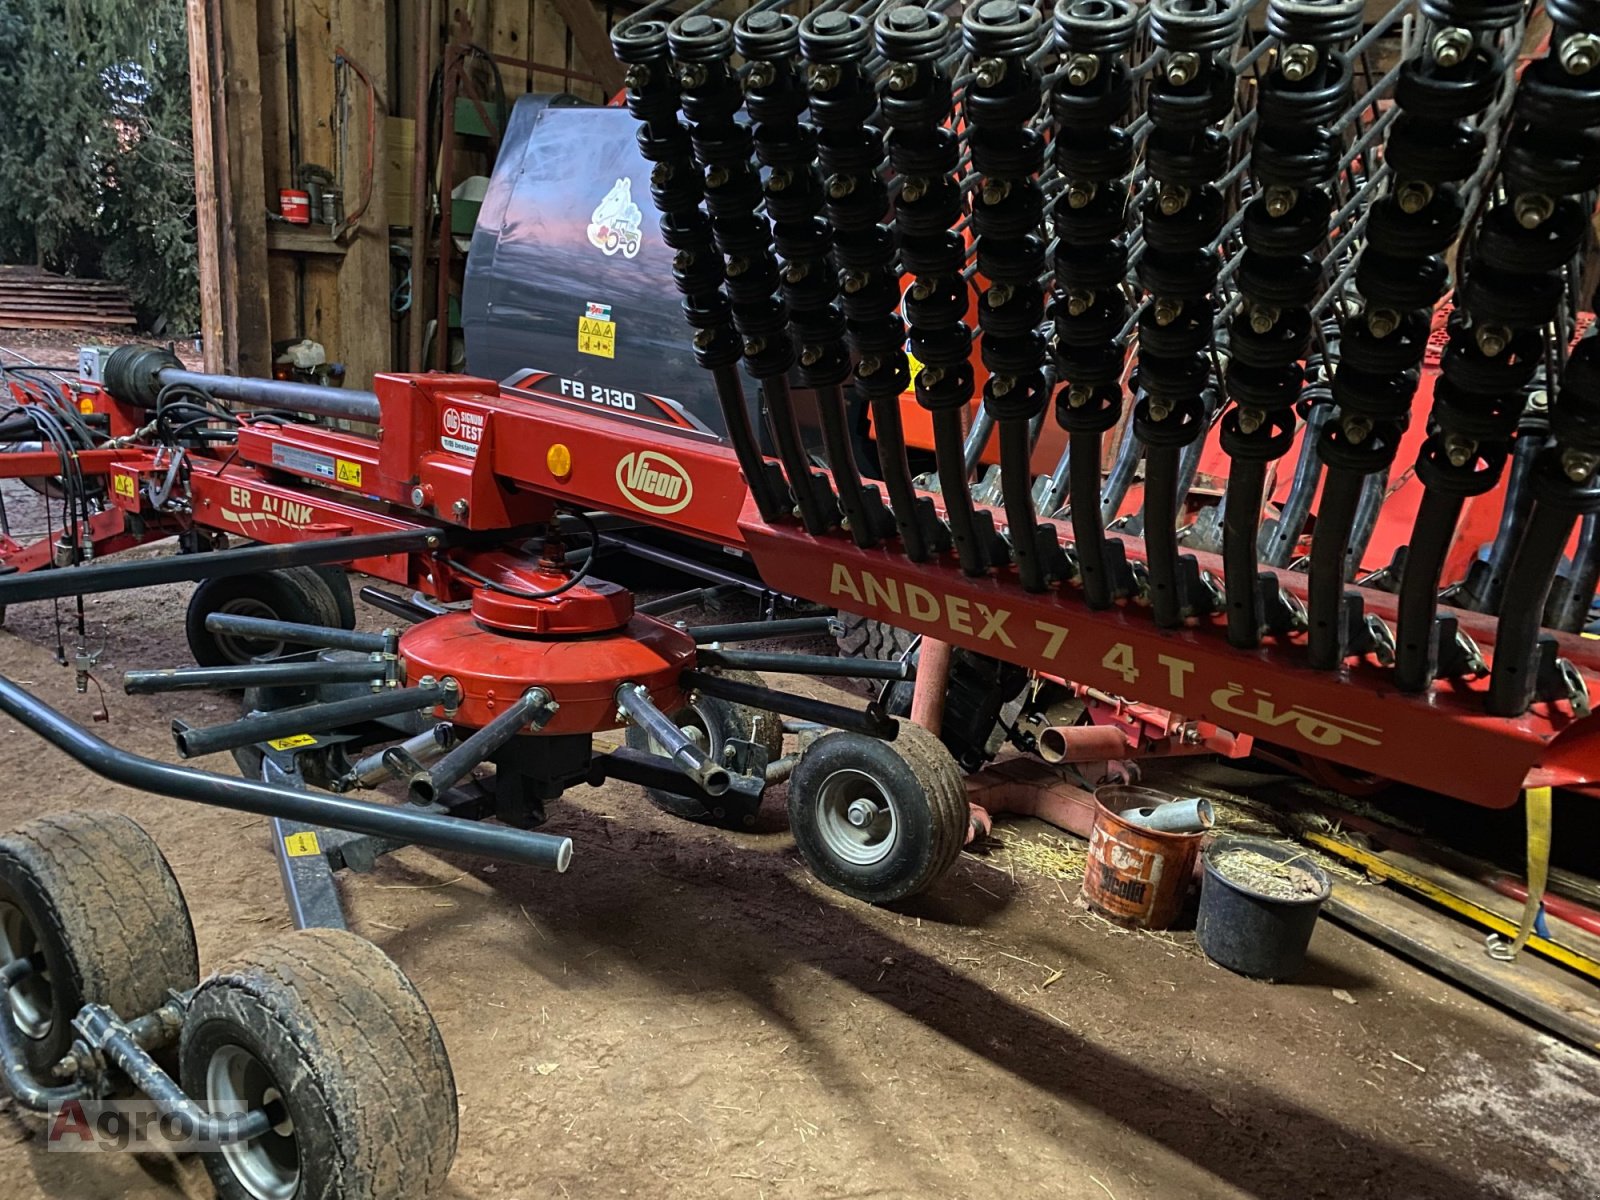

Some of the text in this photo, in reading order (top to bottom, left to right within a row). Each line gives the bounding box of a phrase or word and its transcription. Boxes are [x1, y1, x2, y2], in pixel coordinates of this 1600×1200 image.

[560, 378, 636, 411] FB 2130
[460, 411, 484, 428] SIGNUM
[460, 423, 484, 442] TEST
[621, 451, 685, 503] Vicon
[830, 563, 1017, 649] ANDEX
[1035, 620, 1069, 660] 7
